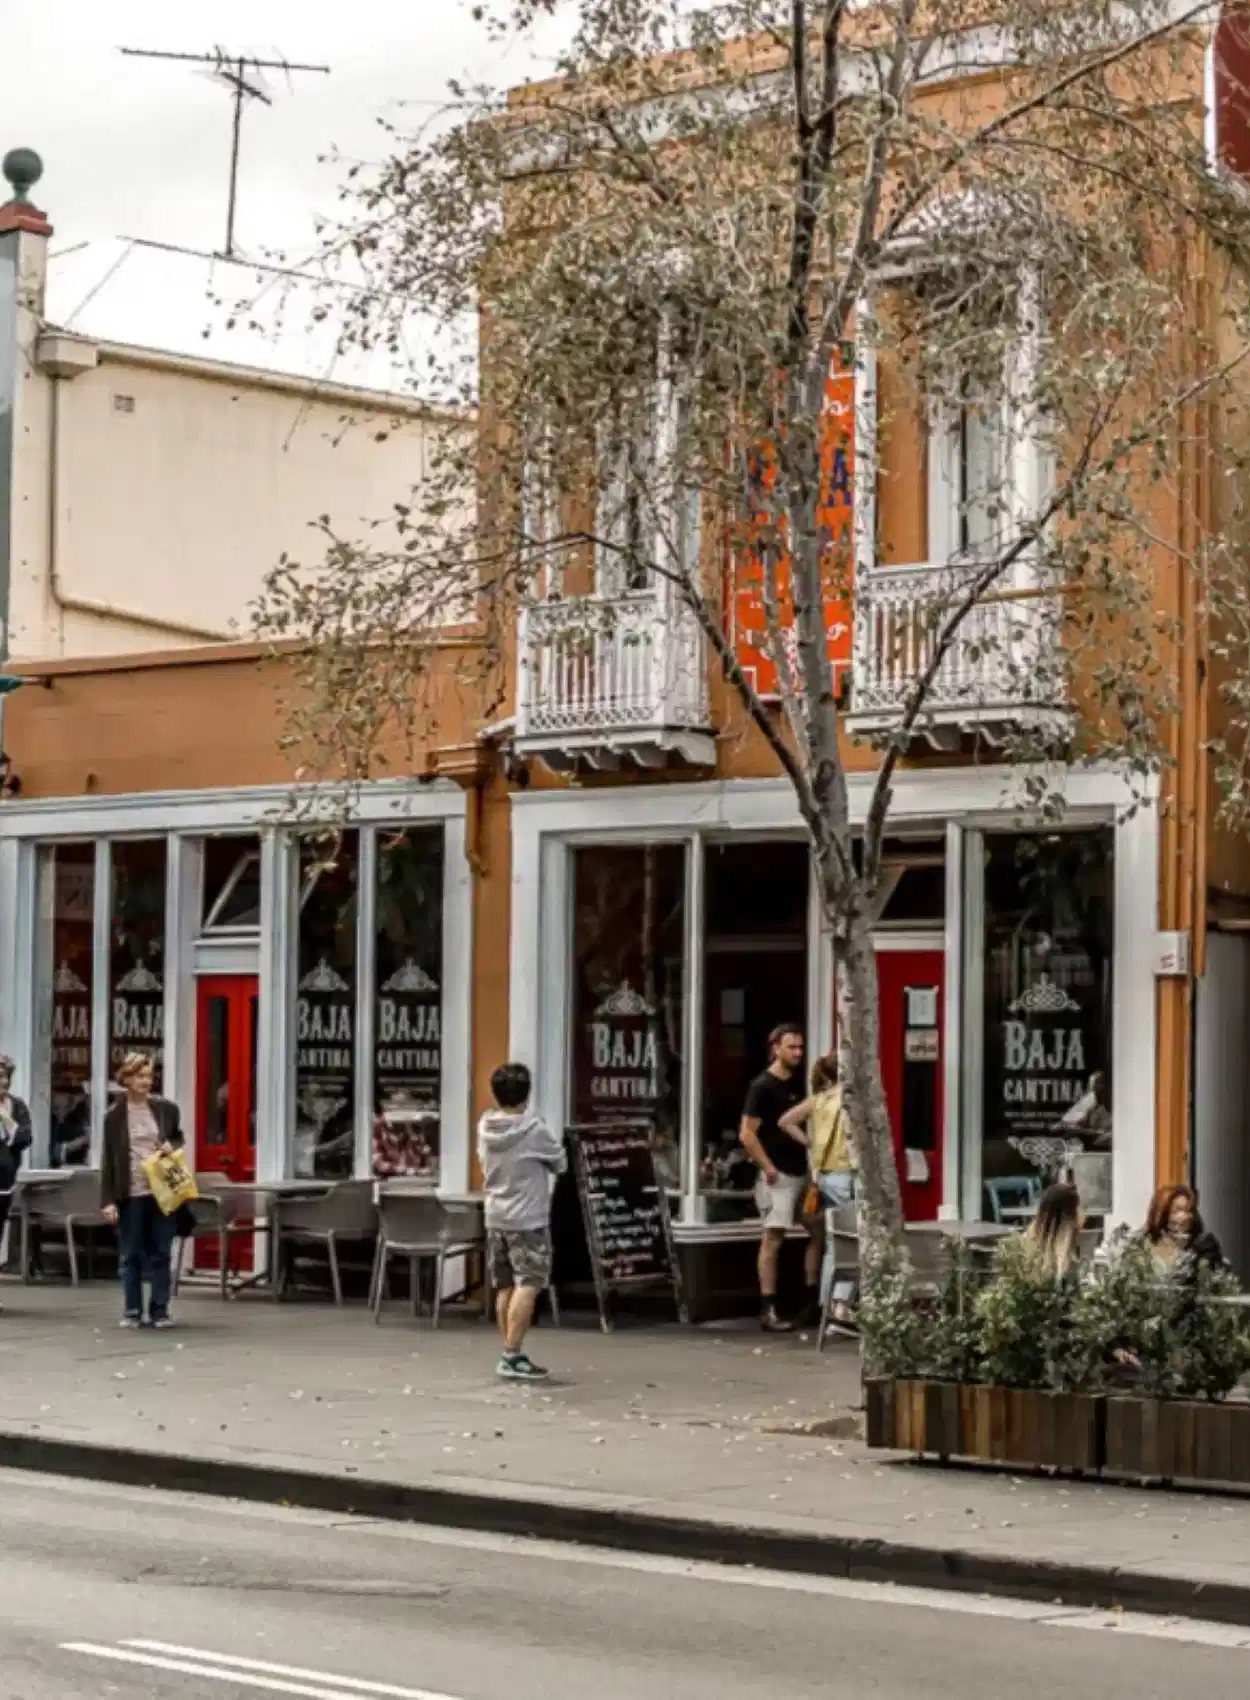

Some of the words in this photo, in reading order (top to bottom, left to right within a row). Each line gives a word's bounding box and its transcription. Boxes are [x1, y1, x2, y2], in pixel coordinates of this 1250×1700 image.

[53, 1004, 89, 1039] AJA
[381, 998, 440, 1041] BAJA
[592, 1023, 657, 1069] BAJA
[1002, 1020, 1085, 1070] BAJA
[1003, 1079, 1085, 1102] CANTINA
